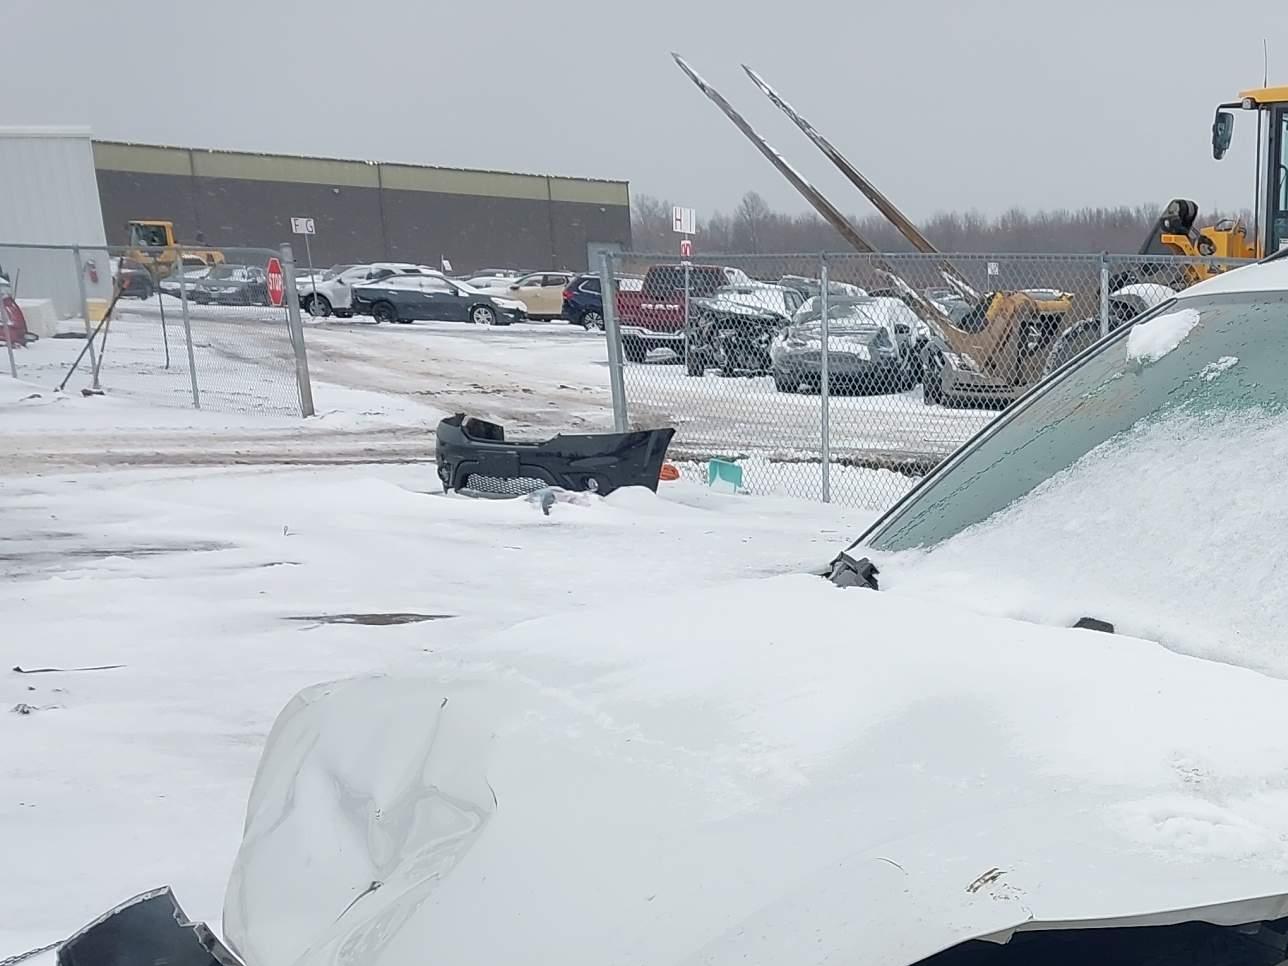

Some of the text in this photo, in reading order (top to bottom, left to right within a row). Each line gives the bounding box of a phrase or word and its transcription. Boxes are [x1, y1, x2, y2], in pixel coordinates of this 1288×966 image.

[293, 218, 313, 233] F G
[675, 207, 682, 230] H
[268, 272, 283, 291] STOP
